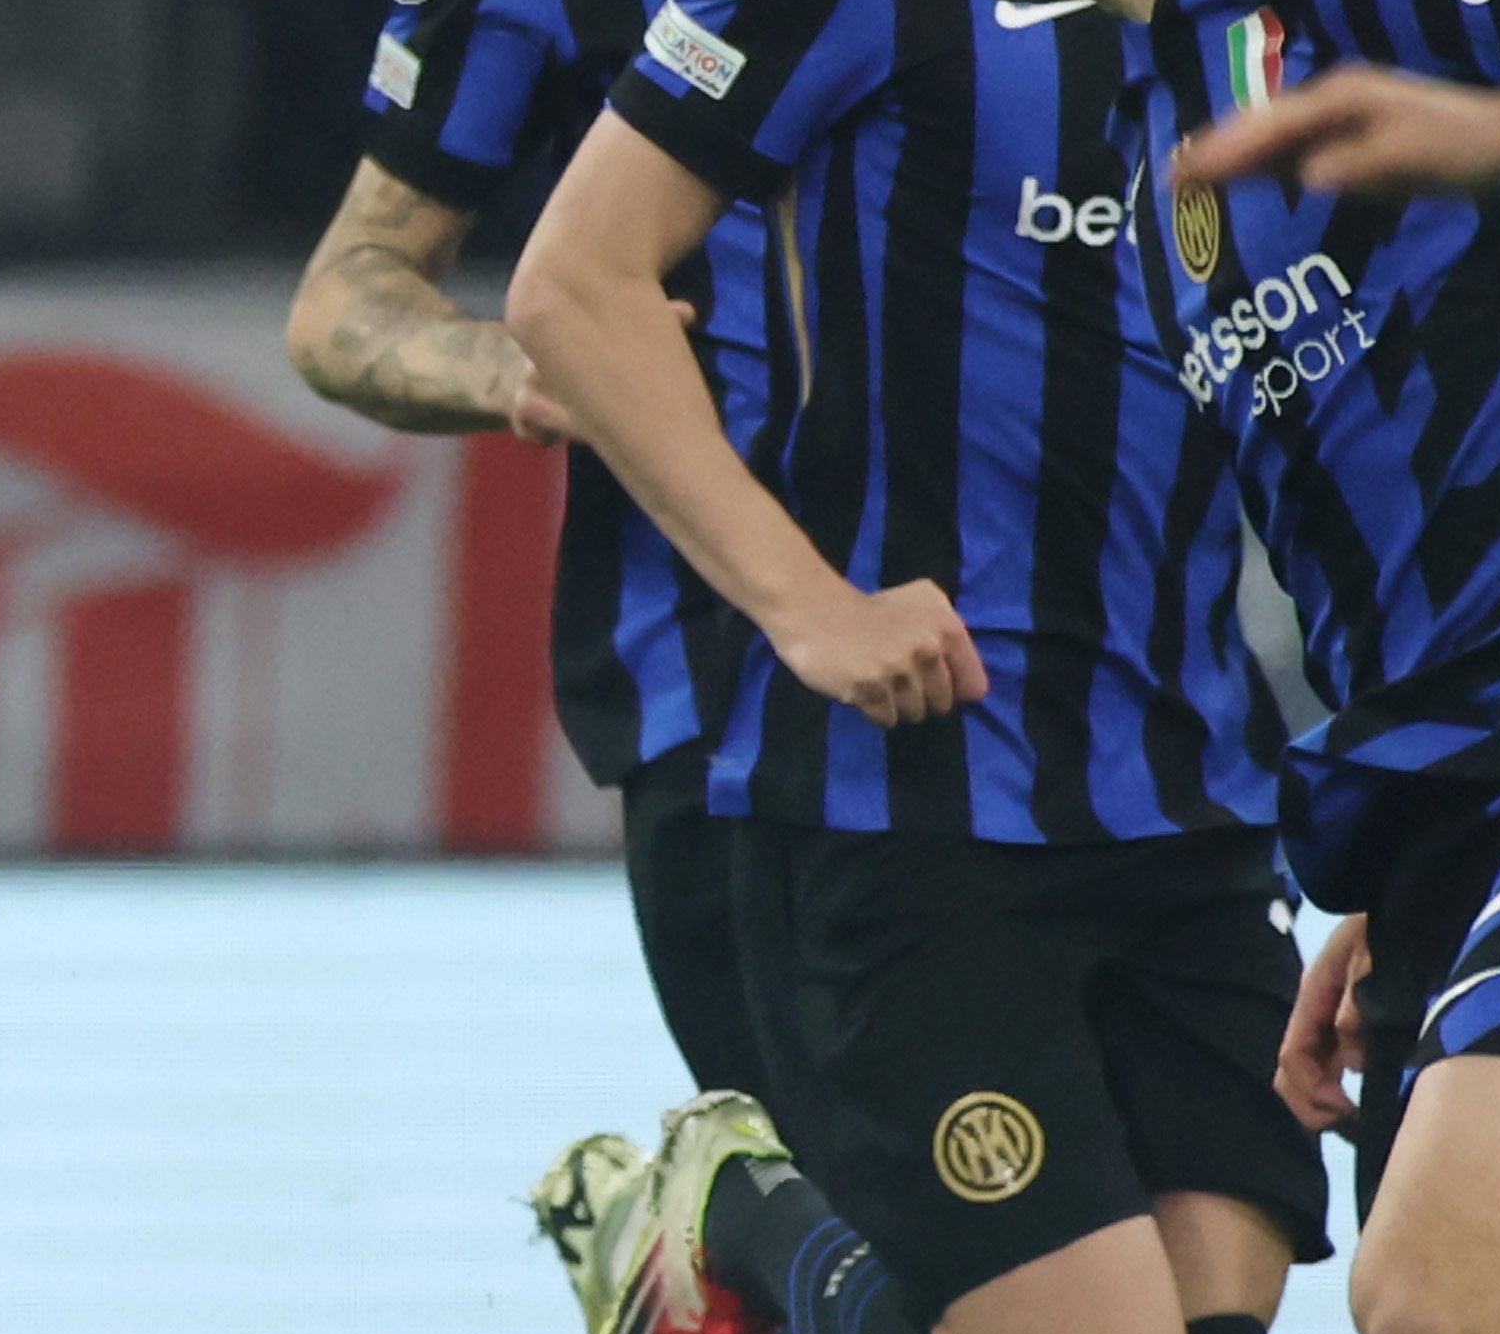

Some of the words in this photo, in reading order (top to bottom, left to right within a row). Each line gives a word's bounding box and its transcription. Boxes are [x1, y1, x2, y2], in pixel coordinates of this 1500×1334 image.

[1014, 161, 1145, 246] be
[1178, 253, 1352, 414] etsson
[1250, 307, 1376, 417] sport
